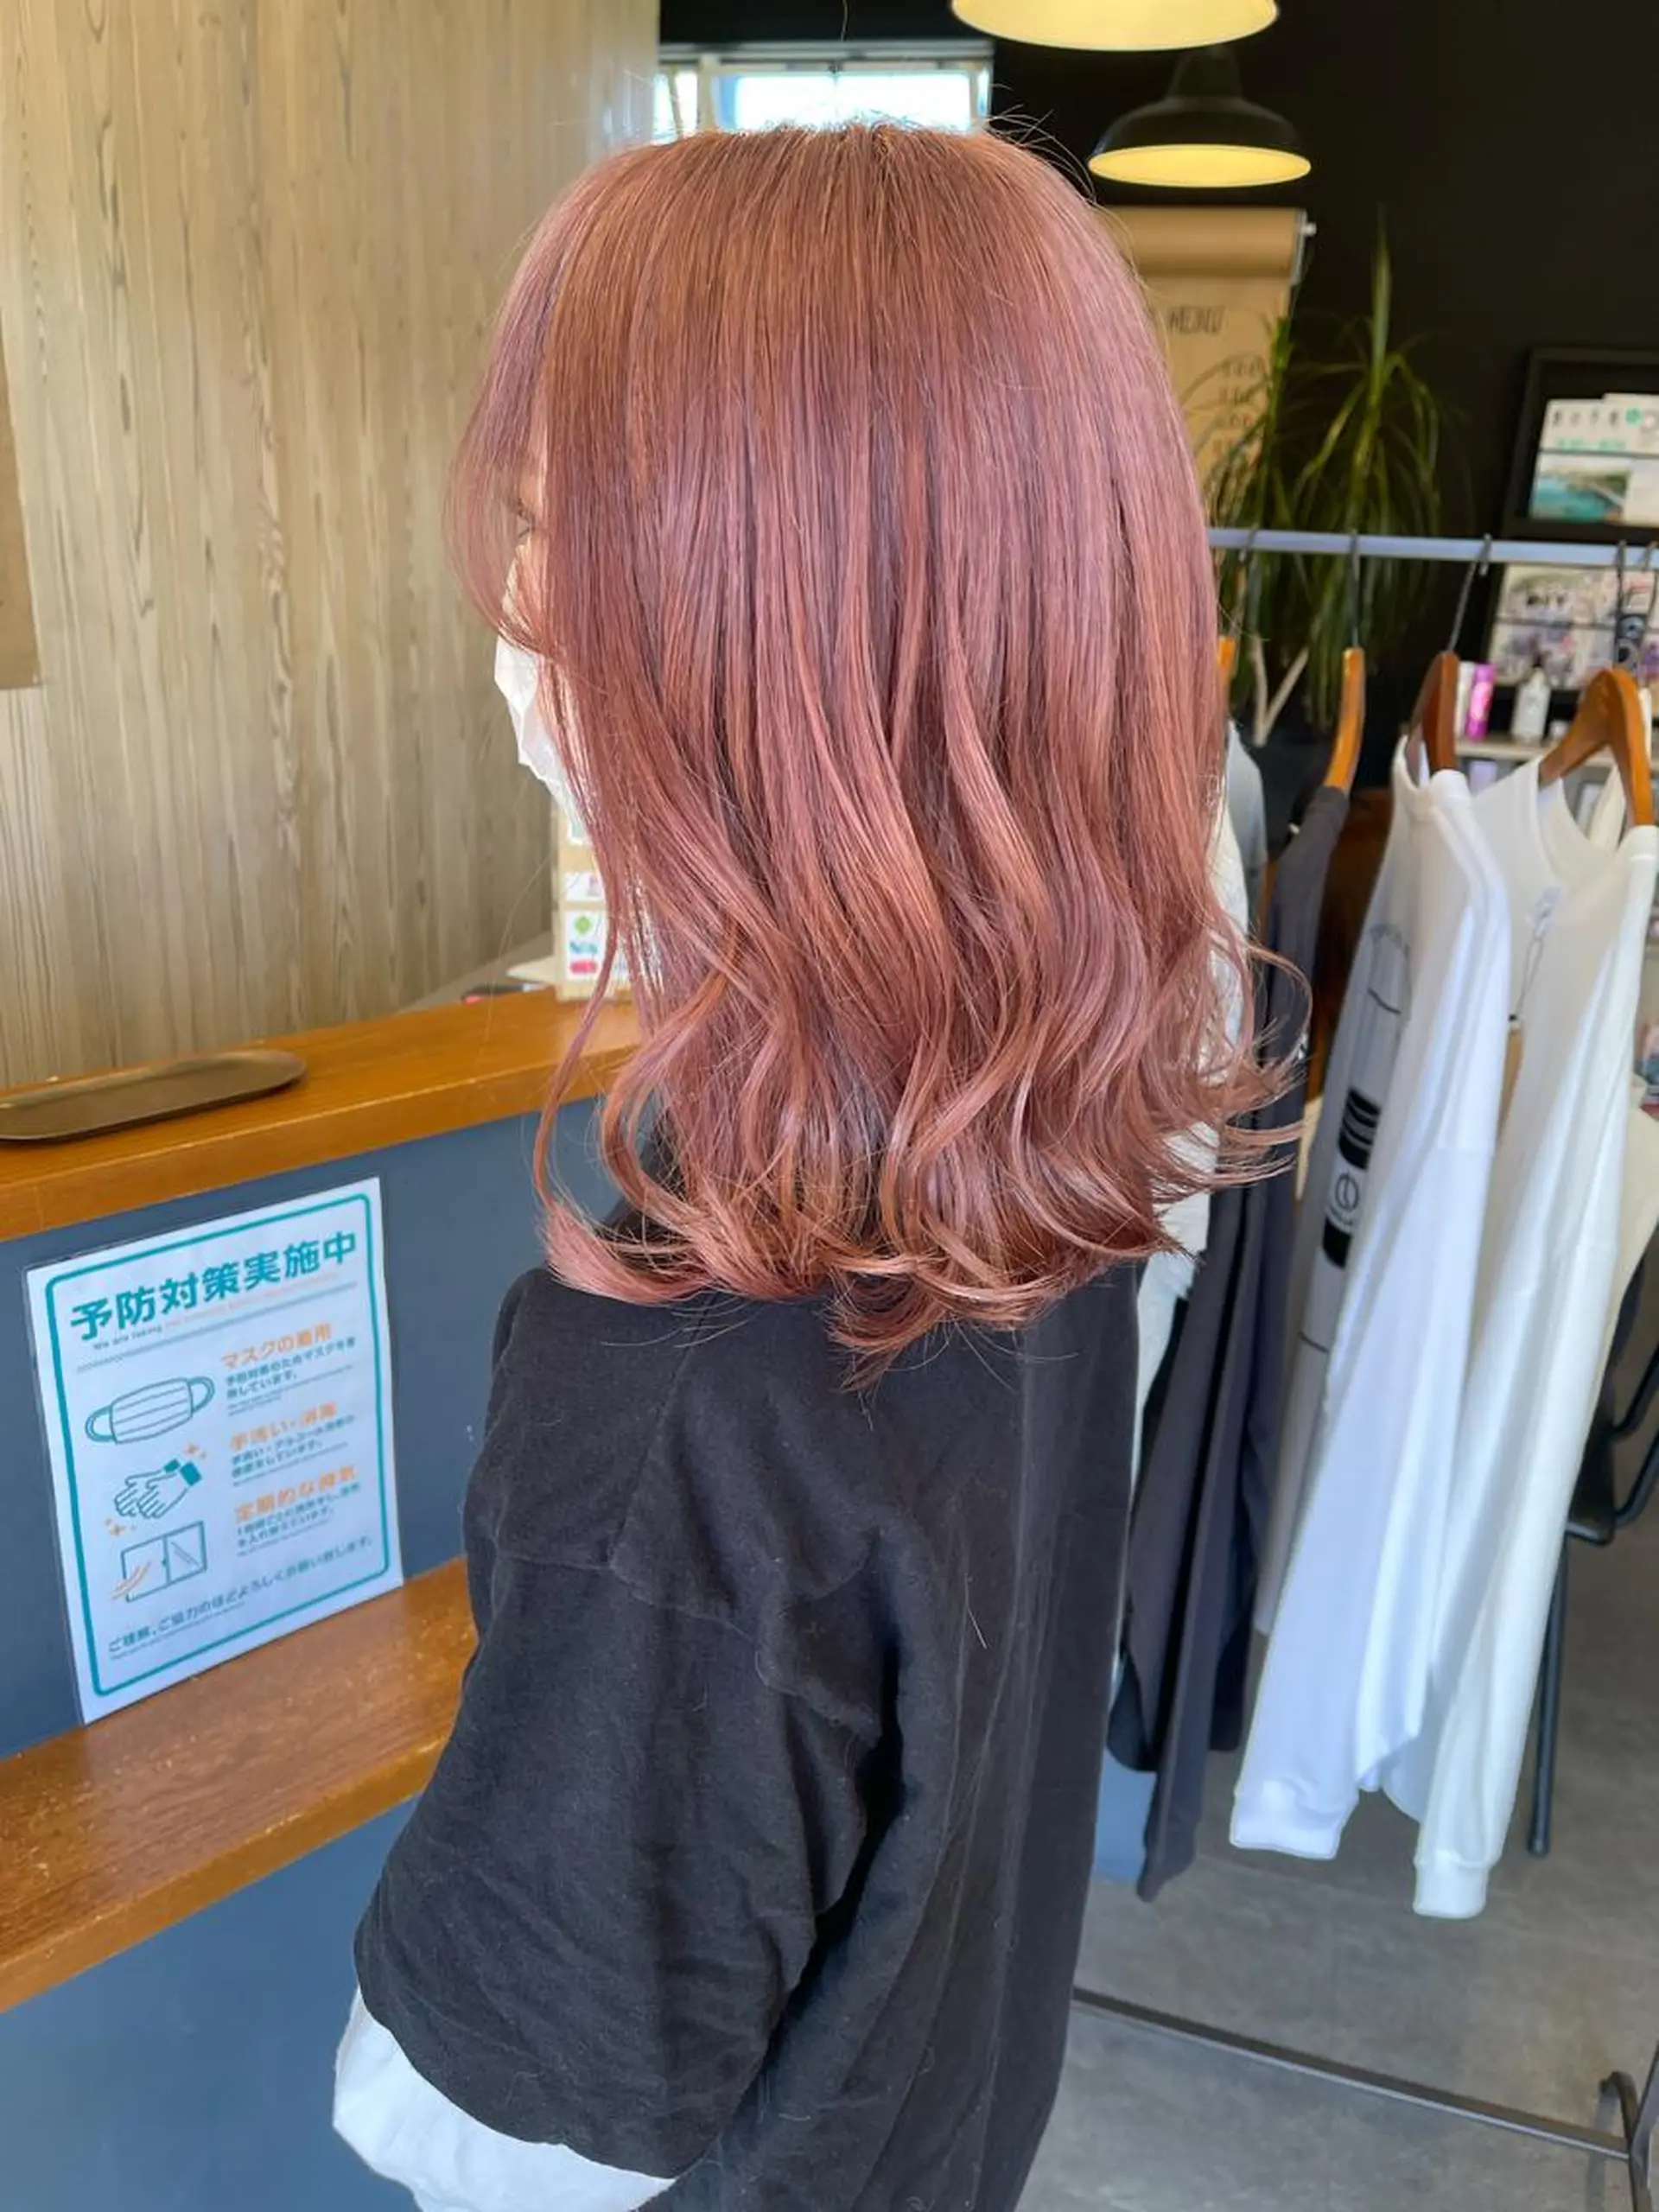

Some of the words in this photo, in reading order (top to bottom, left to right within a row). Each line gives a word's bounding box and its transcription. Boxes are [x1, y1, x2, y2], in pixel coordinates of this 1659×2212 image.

[70, 1231, 356, 1340] 予防対策実施中
